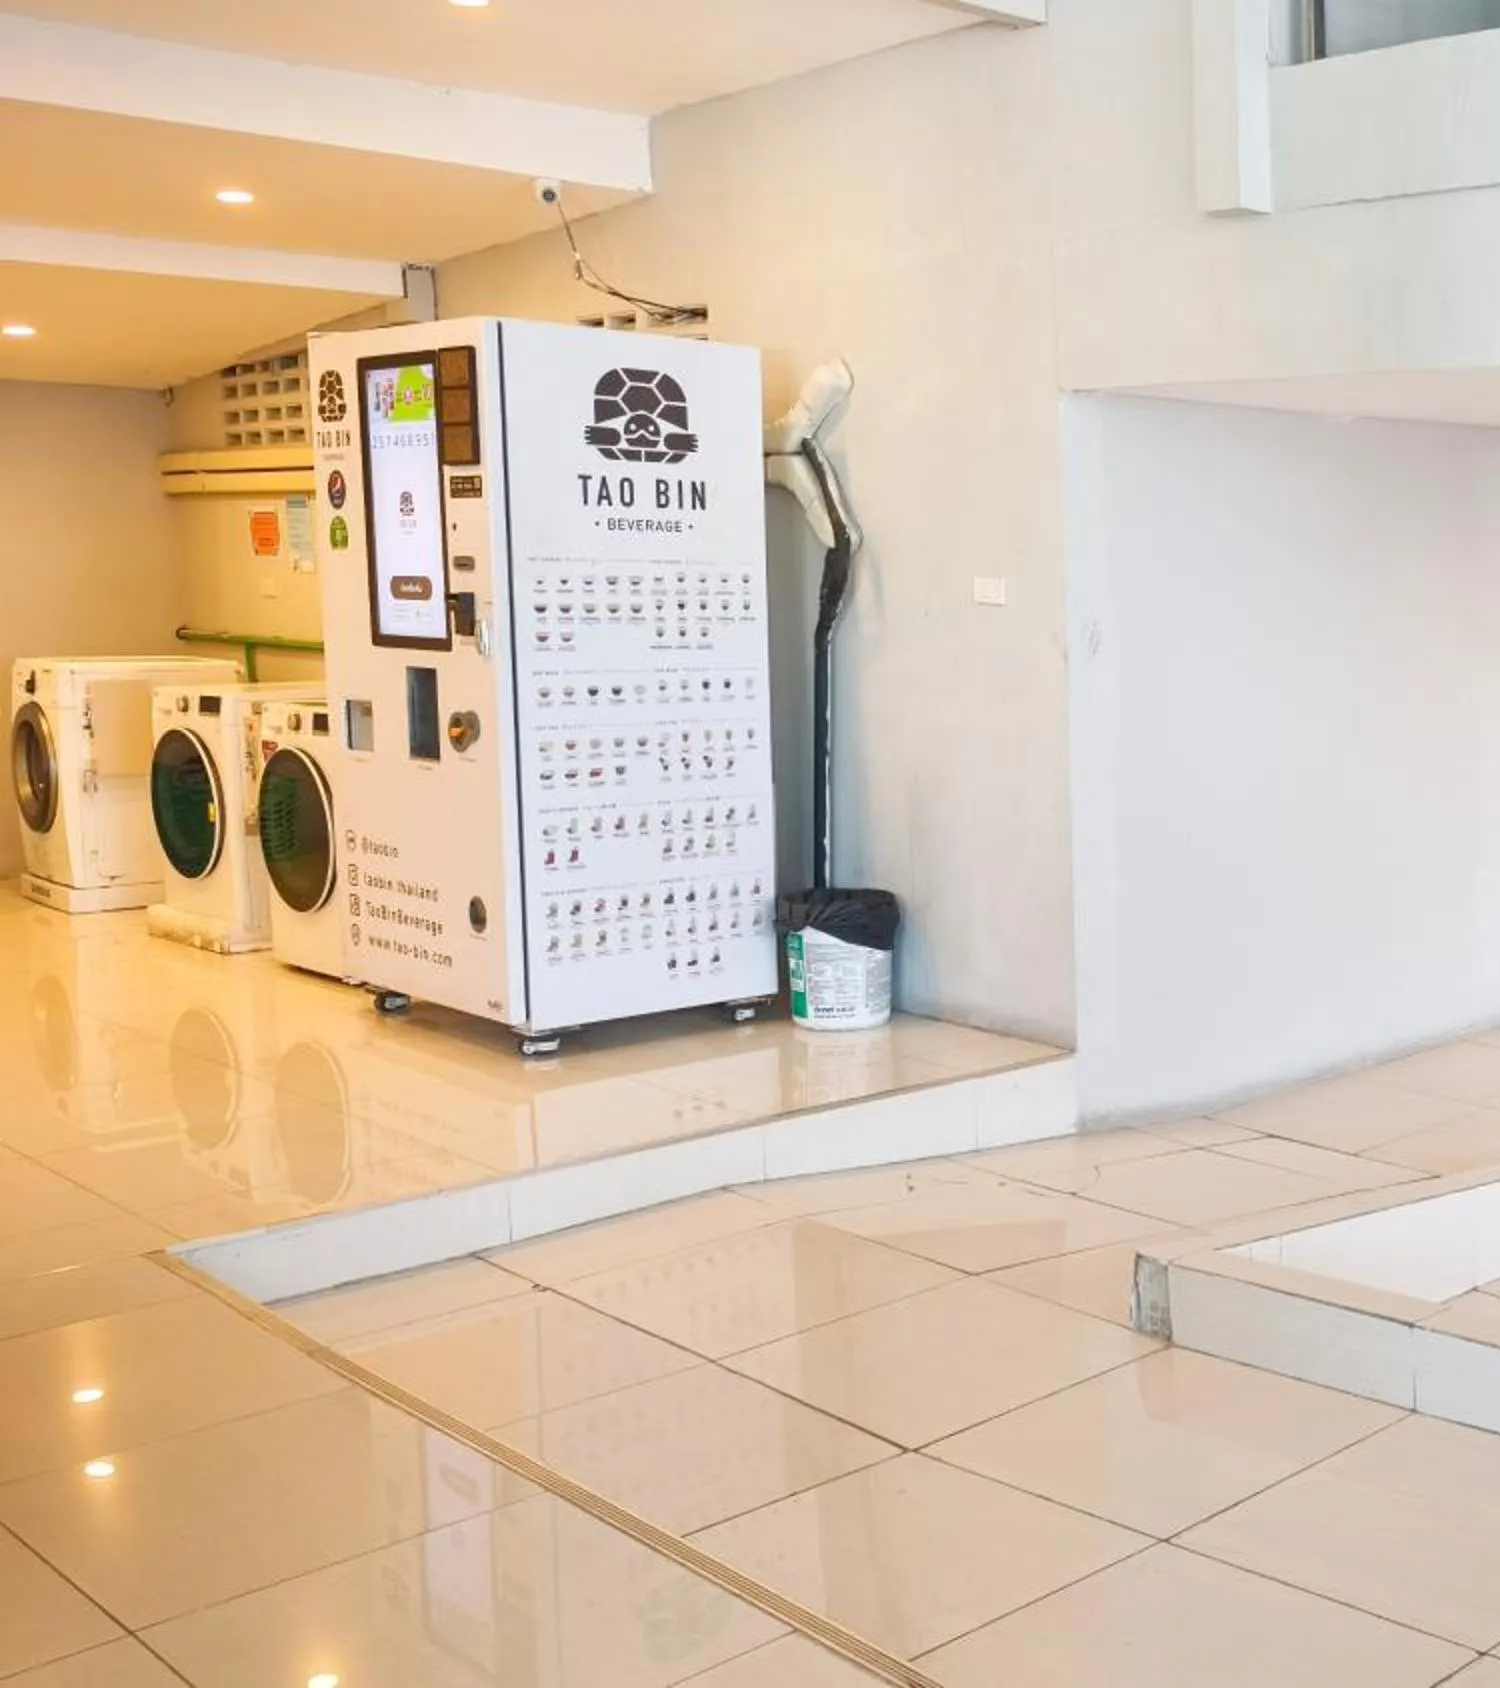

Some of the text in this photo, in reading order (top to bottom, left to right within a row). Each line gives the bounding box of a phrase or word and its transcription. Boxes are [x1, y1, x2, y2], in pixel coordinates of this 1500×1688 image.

[316, 429, 350, 448] TAO BIN
[578, 473, 706, 510] TAO BIN
[607, 518, 682, 533] BEVERAGE
